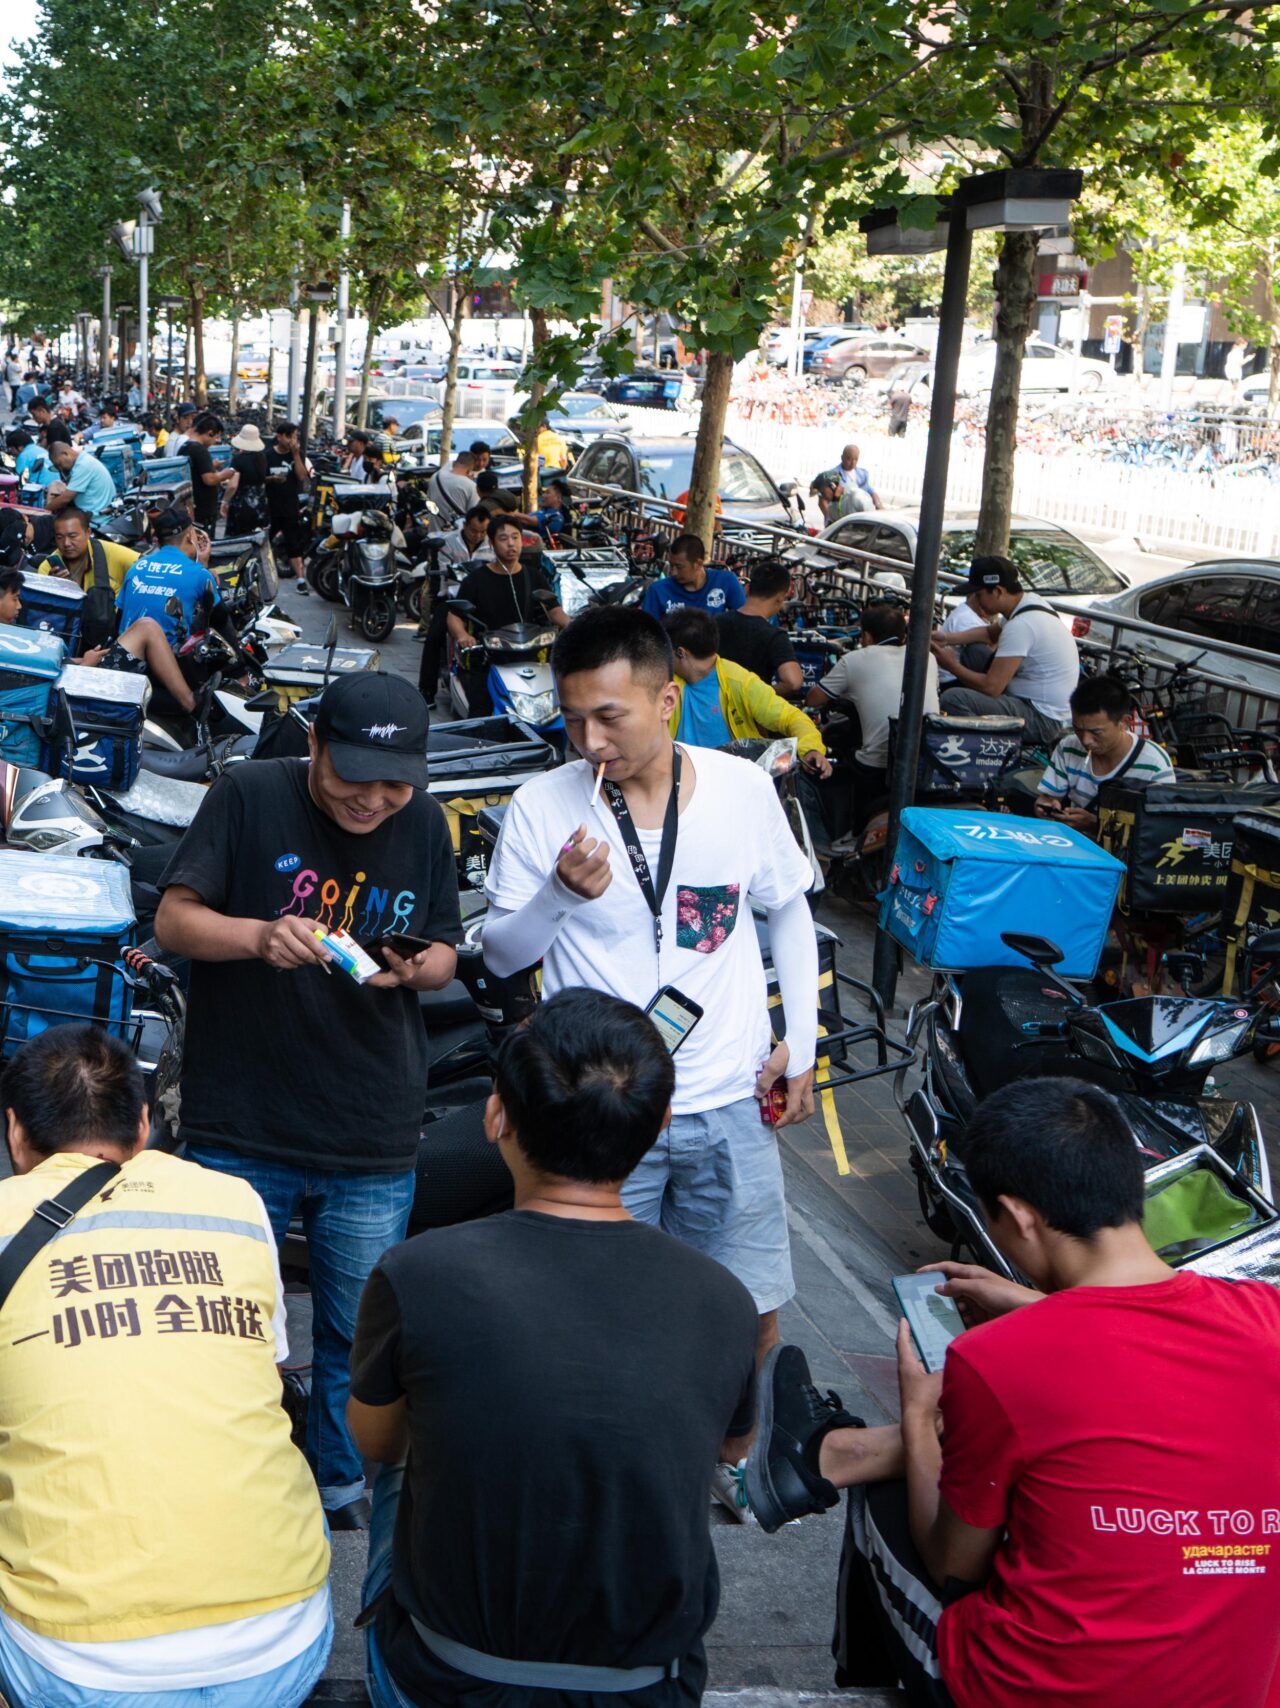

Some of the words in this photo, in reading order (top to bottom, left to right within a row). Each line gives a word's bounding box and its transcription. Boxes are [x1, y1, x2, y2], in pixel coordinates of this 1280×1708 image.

[278, 857, 298, 869] KEEP
[48, 1250, 224, 1298] 美团跑腿
[12, 1298, 142, 1348] 一小时
[154, 1294, 267, 1343] 全城送
[1090, 1505, 1201, 1535] LUCK
[1208, 1509, 1255, 1535] TO
[1182, 1544, 1271, 1559] удачарастет
[1221, 1559, 1233, 1567] TO
[1235, 1559, 1256, 1567] RISE
[1235, 1566, 1266, 1574] MONTE
